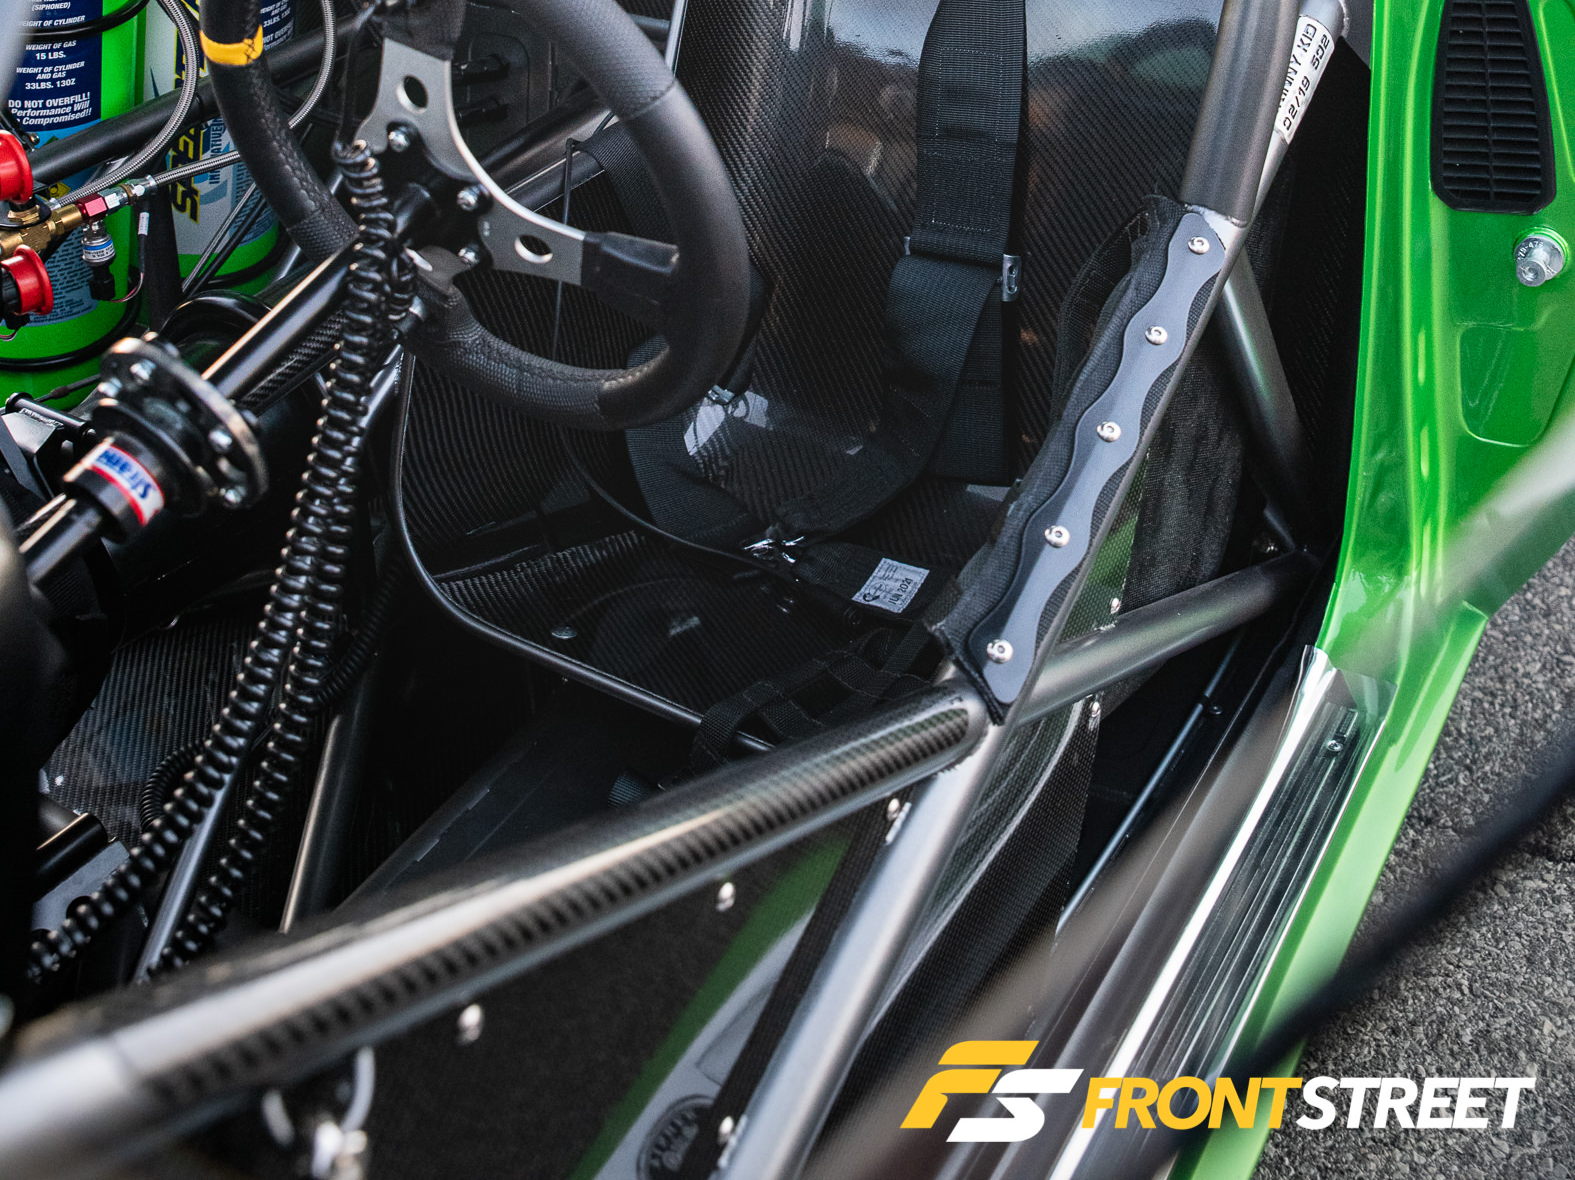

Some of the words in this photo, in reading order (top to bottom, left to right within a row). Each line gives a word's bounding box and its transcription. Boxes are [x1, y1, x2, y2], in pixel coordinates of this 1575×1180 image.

[31, 2, 71, 12] (SIPHONED)
[53, 15, 86, 26] CYLINDER
[1297, 23, 1317, 53] KID
[25, 43, 52, 51] WEIGHT
[52, 42, 62, 50] OF
[63, 40, 77, 48] GAS
[35, 52, 47, 60] 15
[48, 51, 66, 59] LBS.
[53, 61, 85, 71] CYLINDER
[52, 71, 67, 79] GAS
[25, 81, 54, 90] 33LBS.
[8, 99, 22, 108] DO
[24, 99, 44, 108] NOT
[45, 91, 91, 107] OVERFILL!
[11, 105, 72, 117] Performance
[73, 99, 91, 112] Will
[22, 107, 92, 126] Compromised!!
